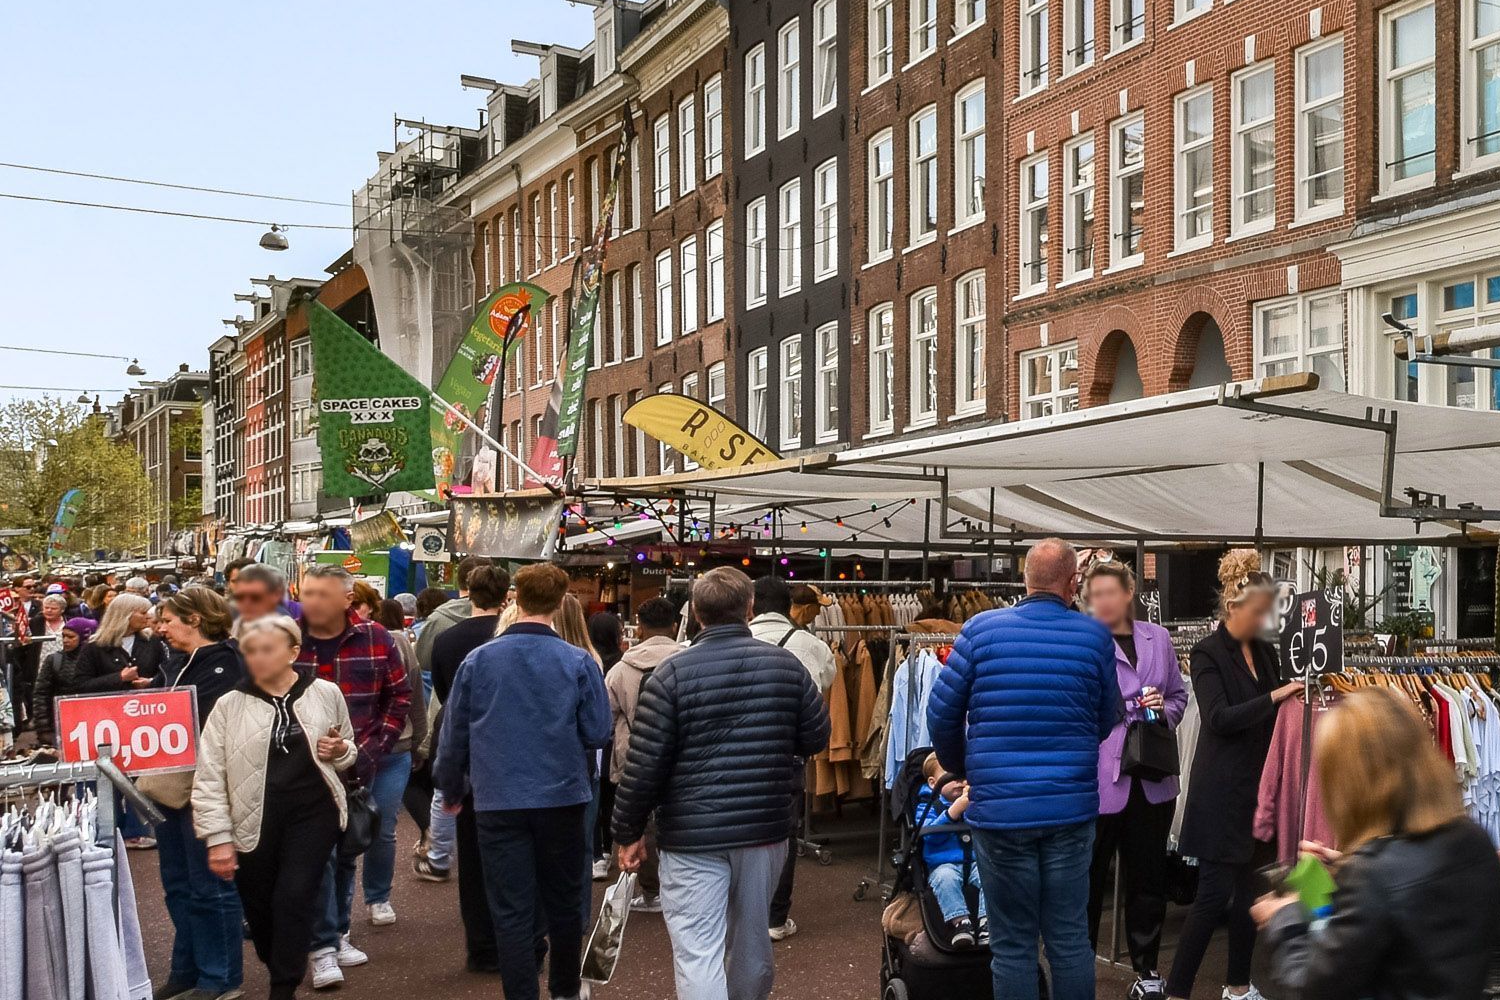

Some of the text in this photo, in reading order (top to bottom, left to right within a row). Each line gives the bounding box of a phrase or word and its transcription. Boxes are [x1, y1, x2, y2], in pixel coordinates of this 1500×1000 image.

[322, 400, 369, 411] SPACE
[372, 398, 420, 409] CAKES
[338, 426, 409, 450] CANNABIS
[681, 443, 722, 470] BAKE
[69, 719, 189, 767] 10,00
